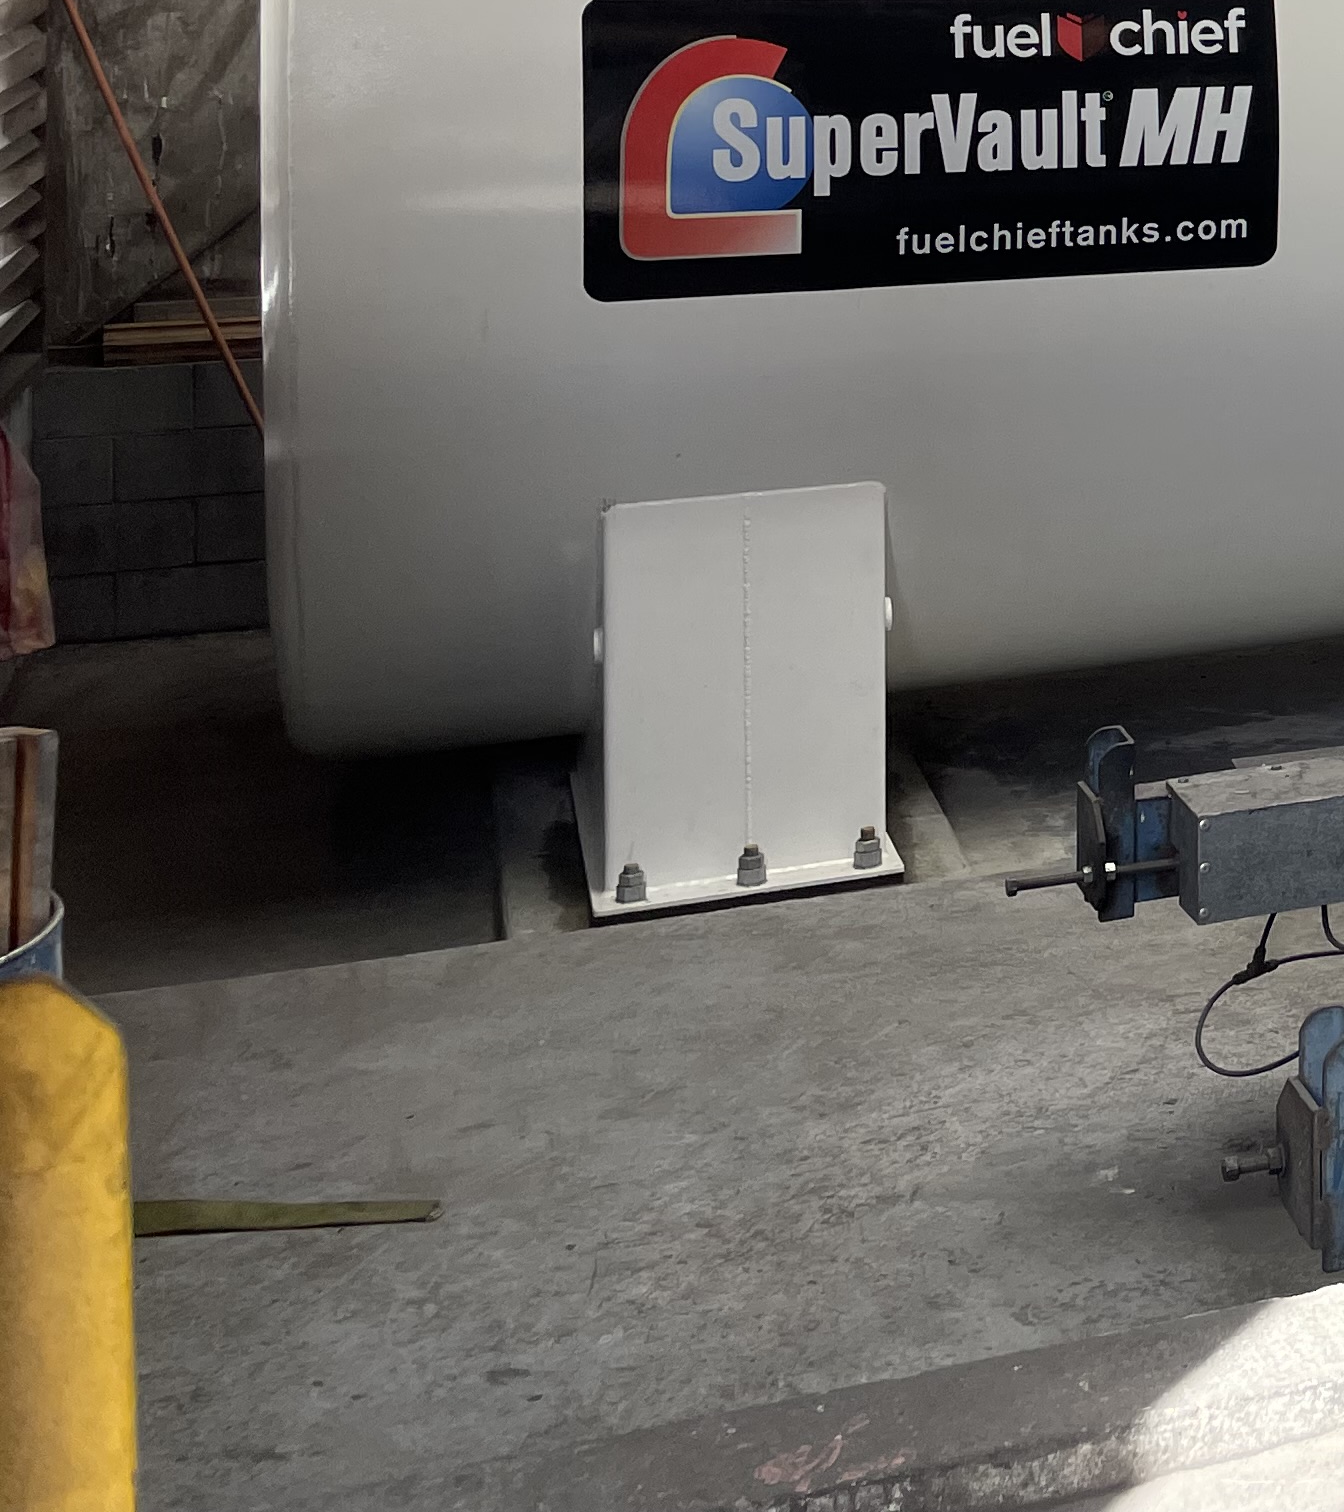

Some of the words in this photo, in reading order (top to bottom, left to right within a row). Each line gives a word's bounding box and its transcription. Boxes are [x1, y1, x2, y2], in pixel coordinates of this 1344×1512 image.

[950, 13, 1052, 59] fuel
[1109, 7, 1246, 56] chief
[1119, 85, 1253, 167] MH
[896, 216, 1248, 256] fuelchieftanks.com
